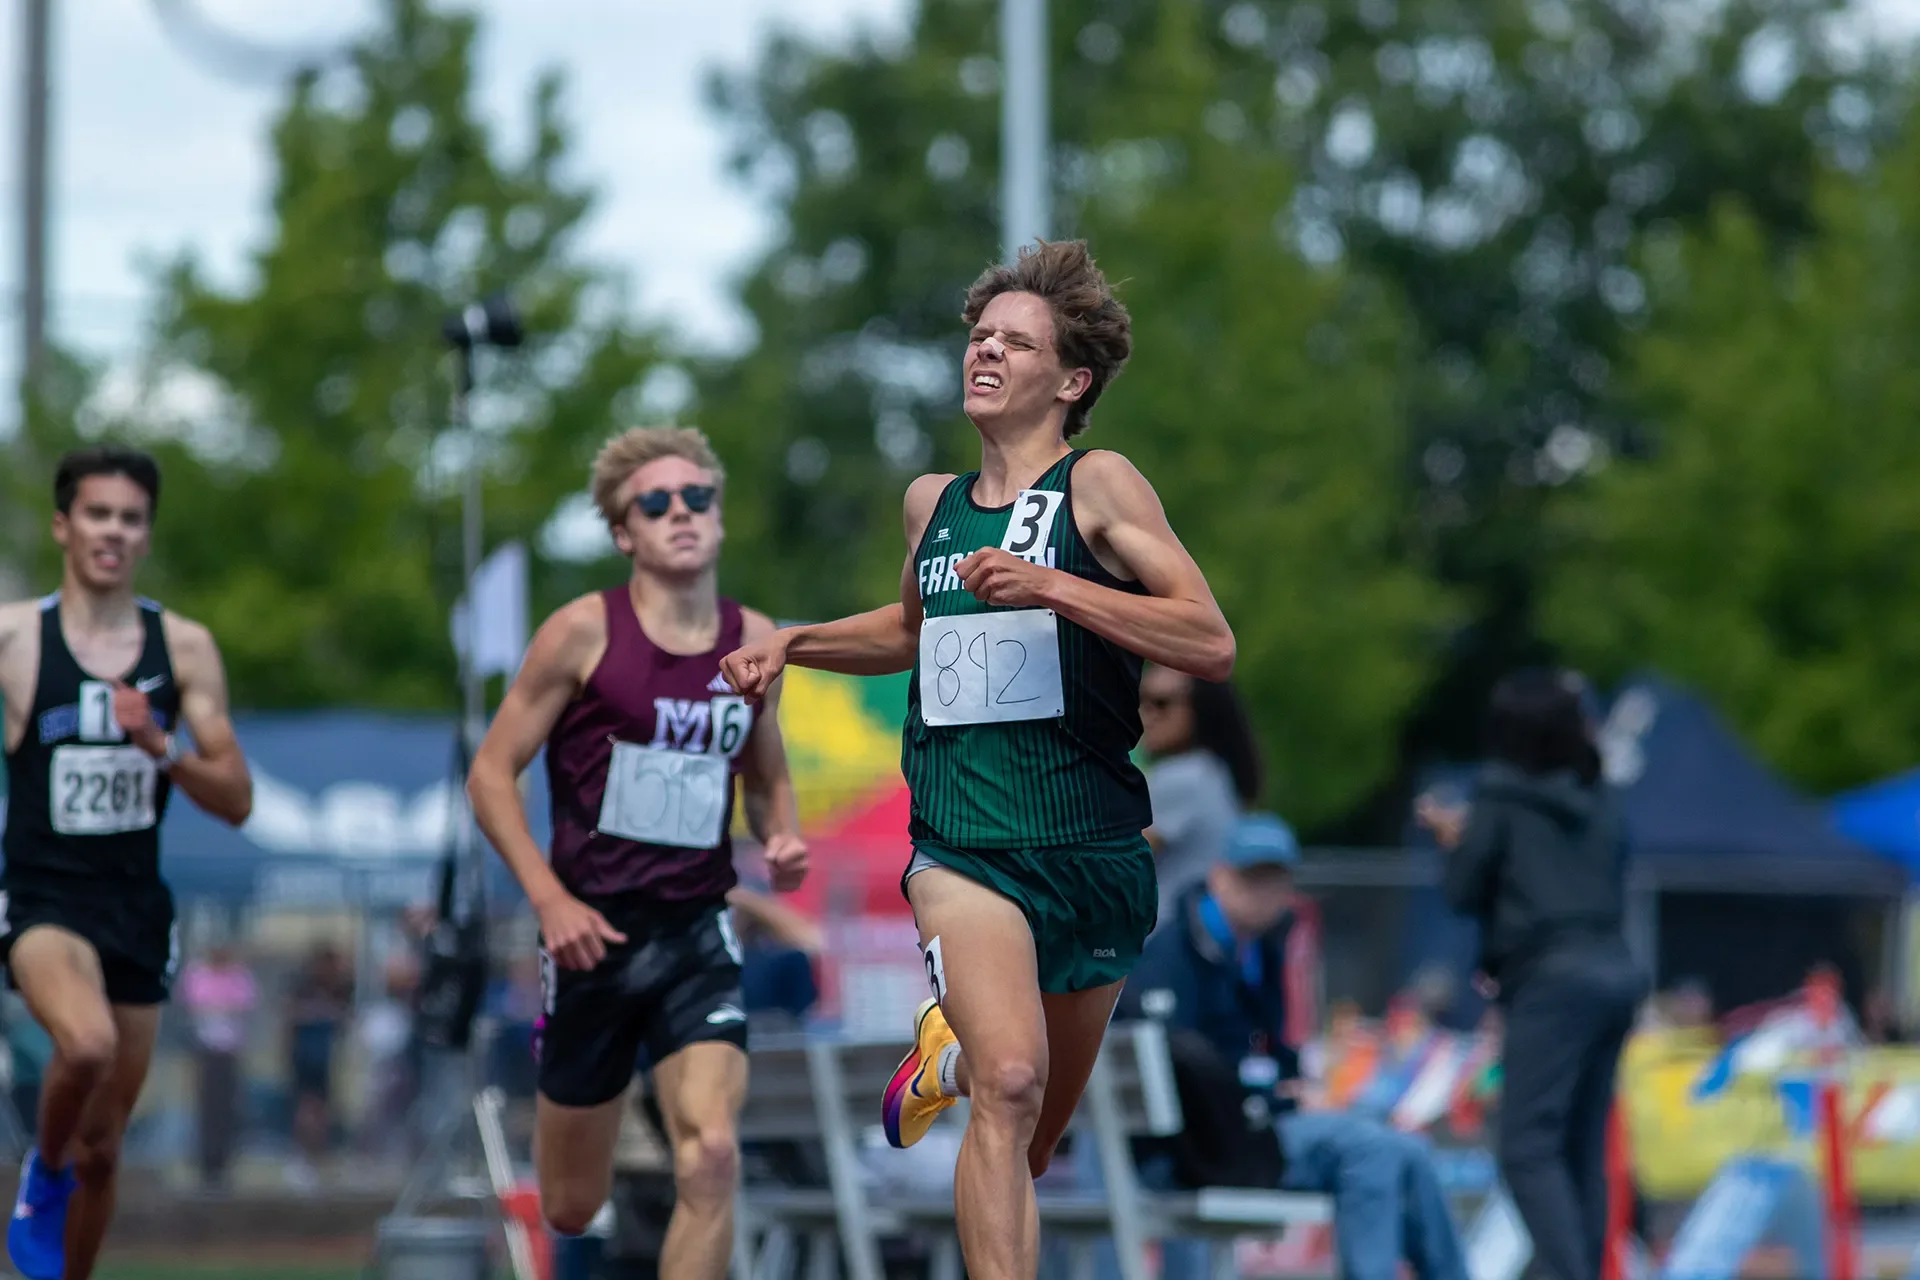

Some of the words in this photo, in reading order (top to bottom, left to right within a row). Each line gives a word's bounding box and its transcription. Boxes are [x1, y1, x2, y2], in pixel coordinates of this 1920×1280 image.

[1009, 494, 1049, 553] 3
[934, 629, 1042, 708] 892
[93, 690, 109, 738] 1
[721, 703, 740, 753] 6
[1092, 947, 1117, 958] BOA
